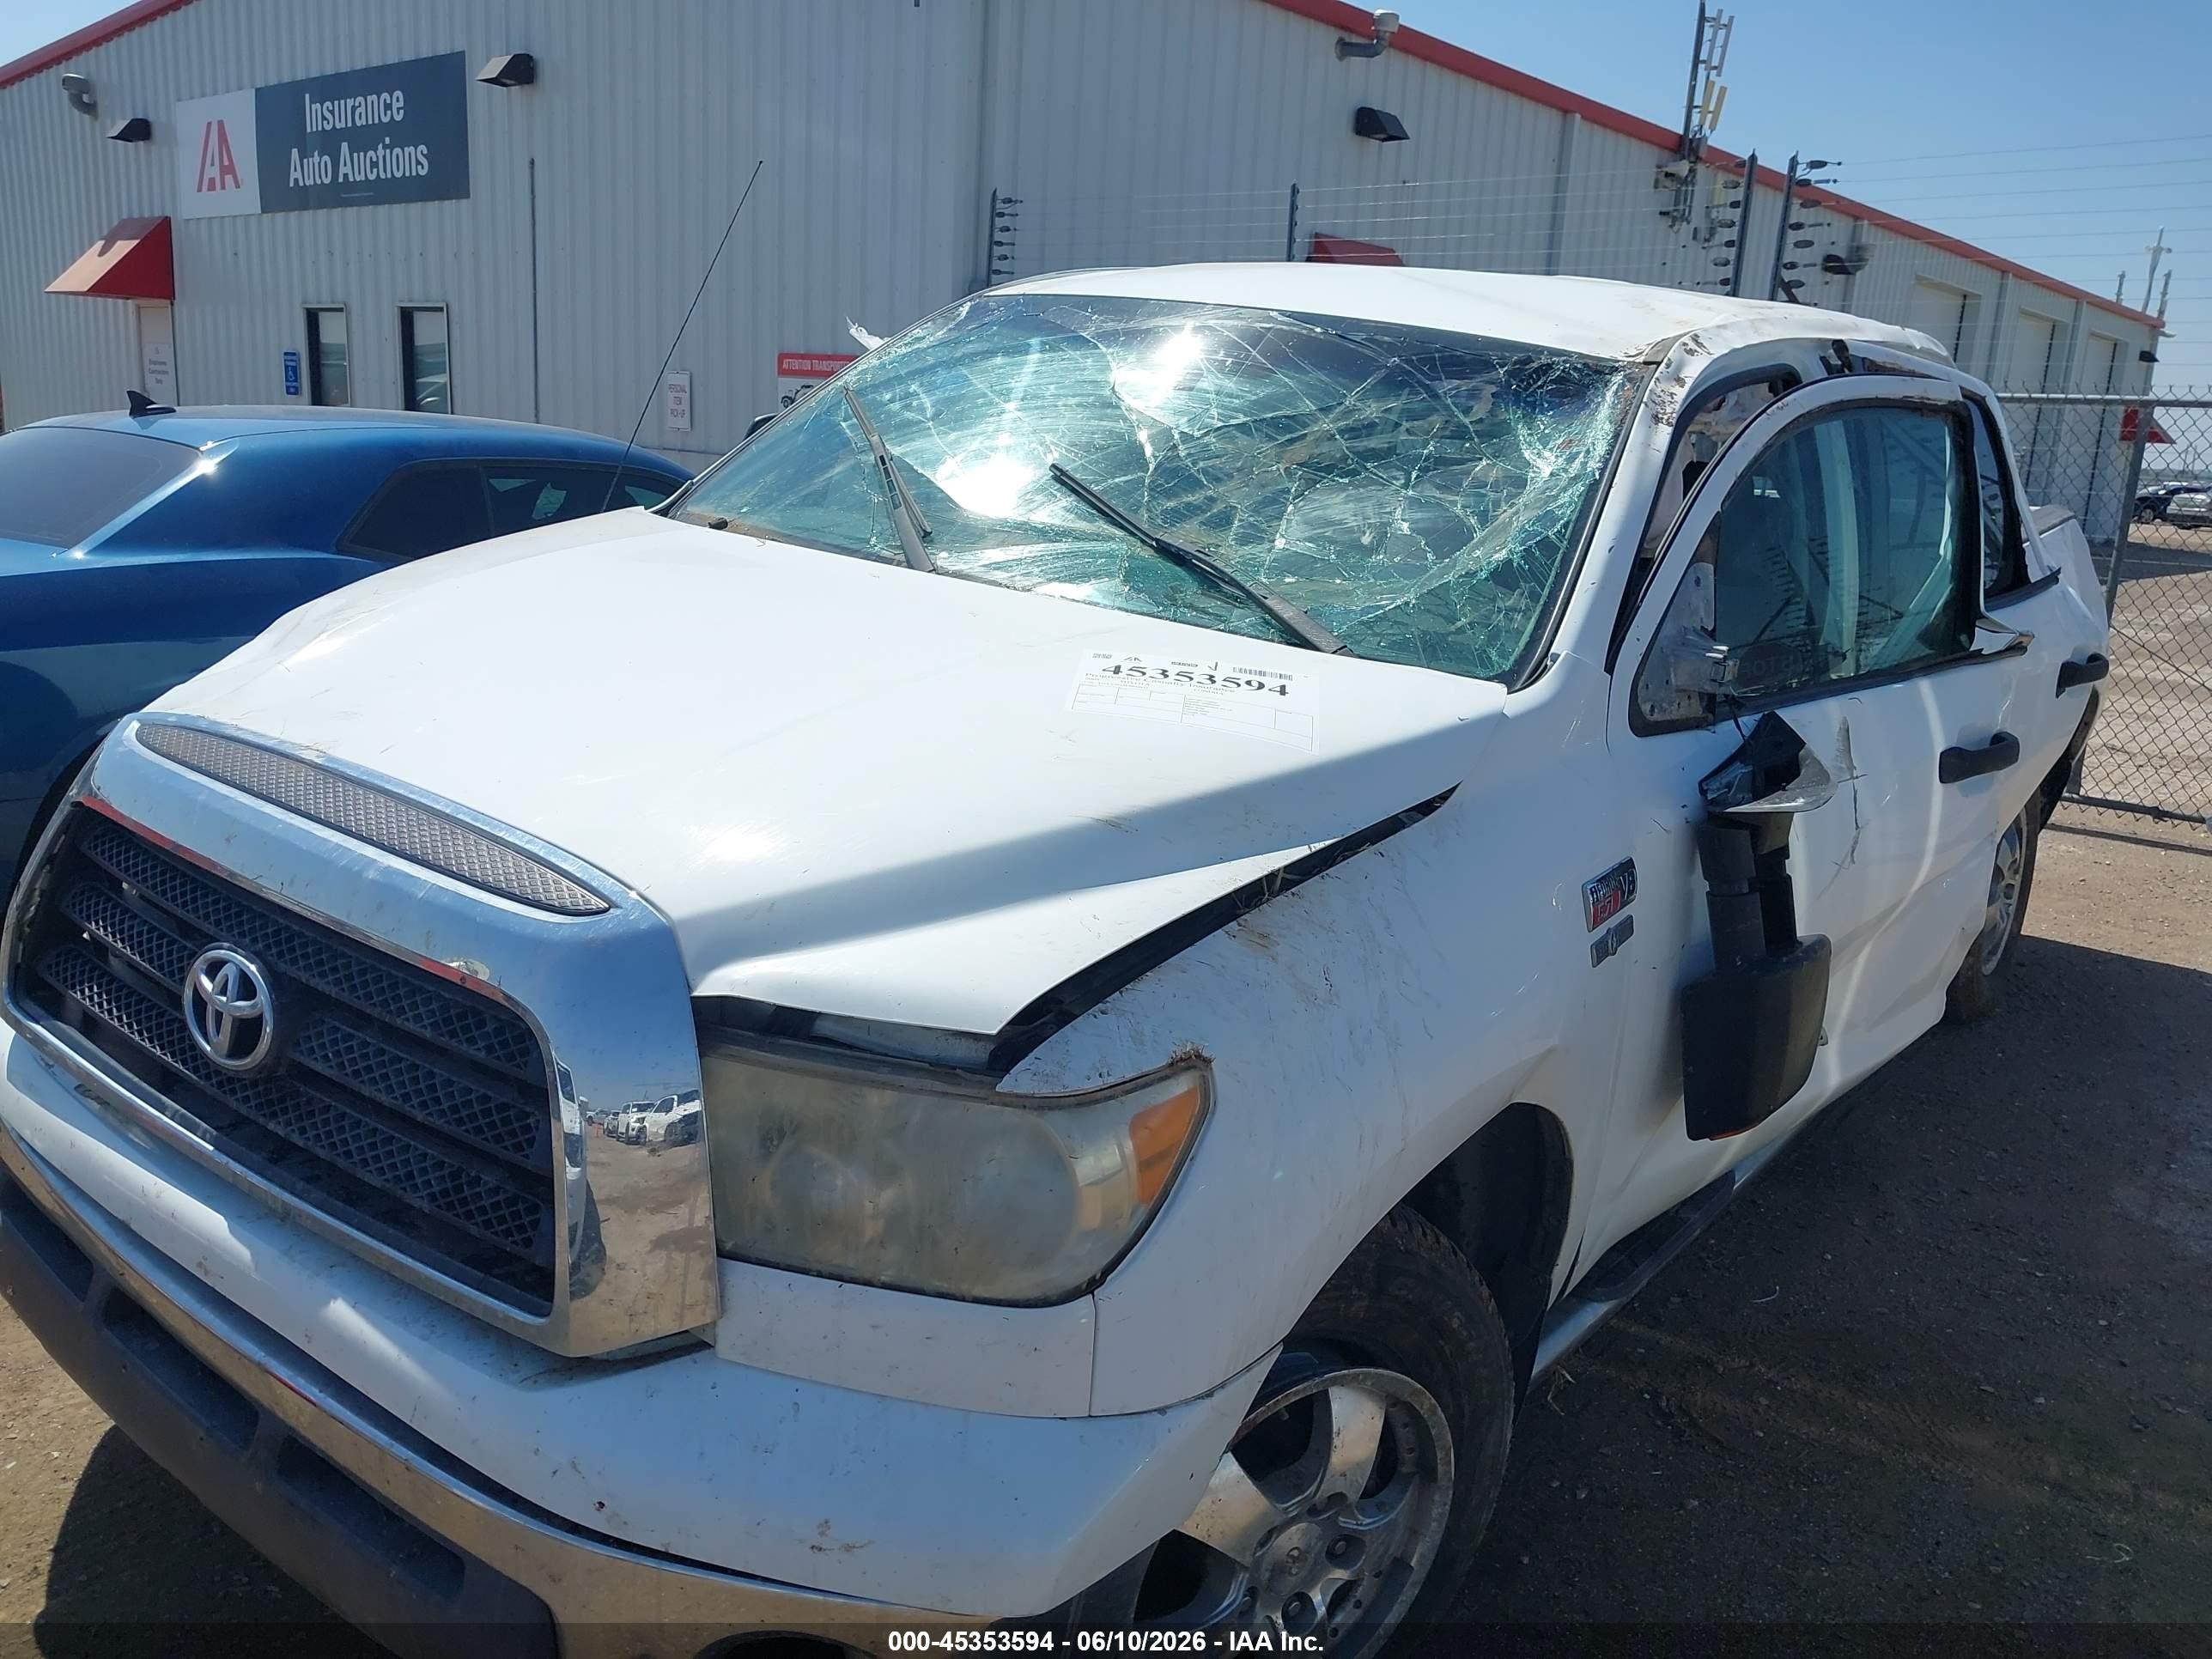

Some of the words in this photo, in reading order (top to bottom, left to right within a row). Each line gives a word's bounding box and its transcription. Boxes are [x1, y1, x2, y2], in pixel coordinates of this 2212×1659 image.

[305, 89, 404, 133] Insurance
[289, 148, 332, 188] Auto
[337, 137, 429, 183] Auctions
[782, 358, 811, 370] ATTENTION
[1102, 664, 1290, 696] 45353594
